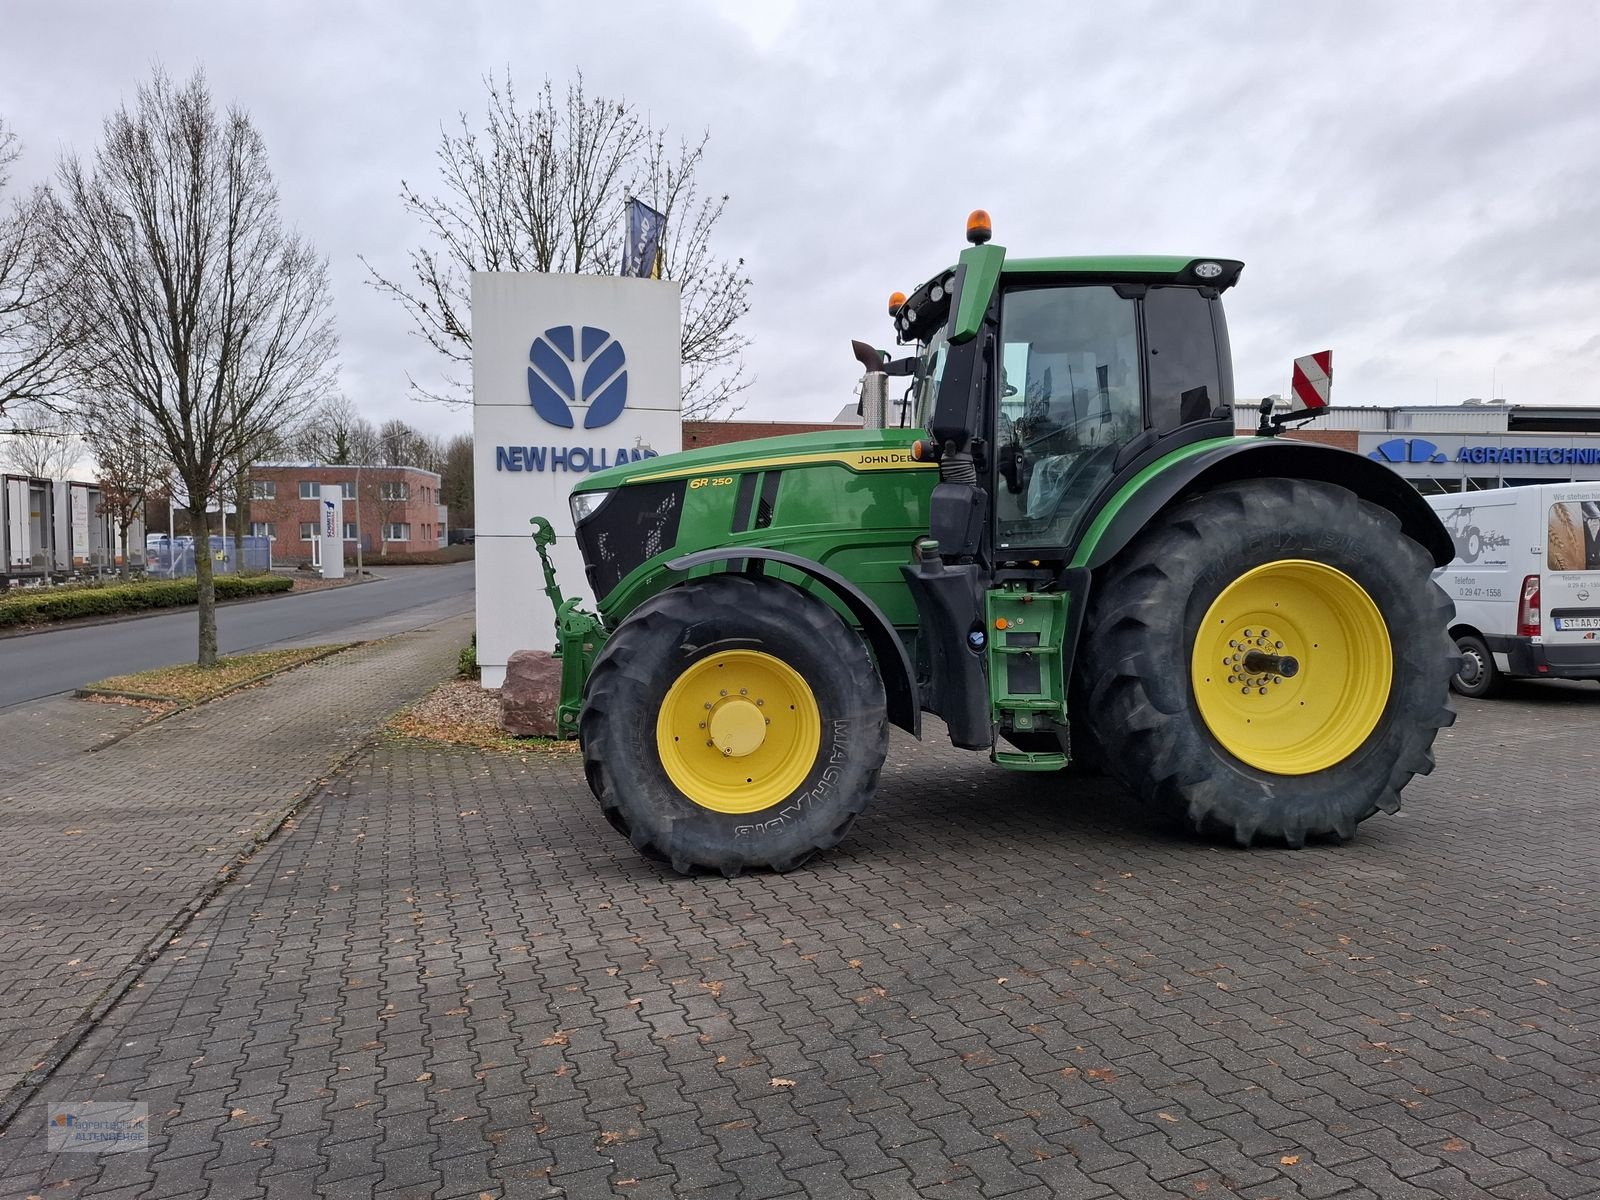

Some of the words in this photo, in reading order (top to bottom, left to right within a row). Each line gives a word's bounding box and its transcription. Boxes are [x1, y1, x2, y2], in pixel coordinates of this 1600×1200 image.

[496, 446, 547, 472] NEW
[858, 455, 888, 464] JOHN
[891, 454, 913, 462] DEE
[690, 478, 708, 489] 6R
[711, 477, 733, 486] 250
[1455, 576, 1475, 584] Telefon
[1564, 619, 1574, 627] ST
[1581, 618, 1593, 627] AA
